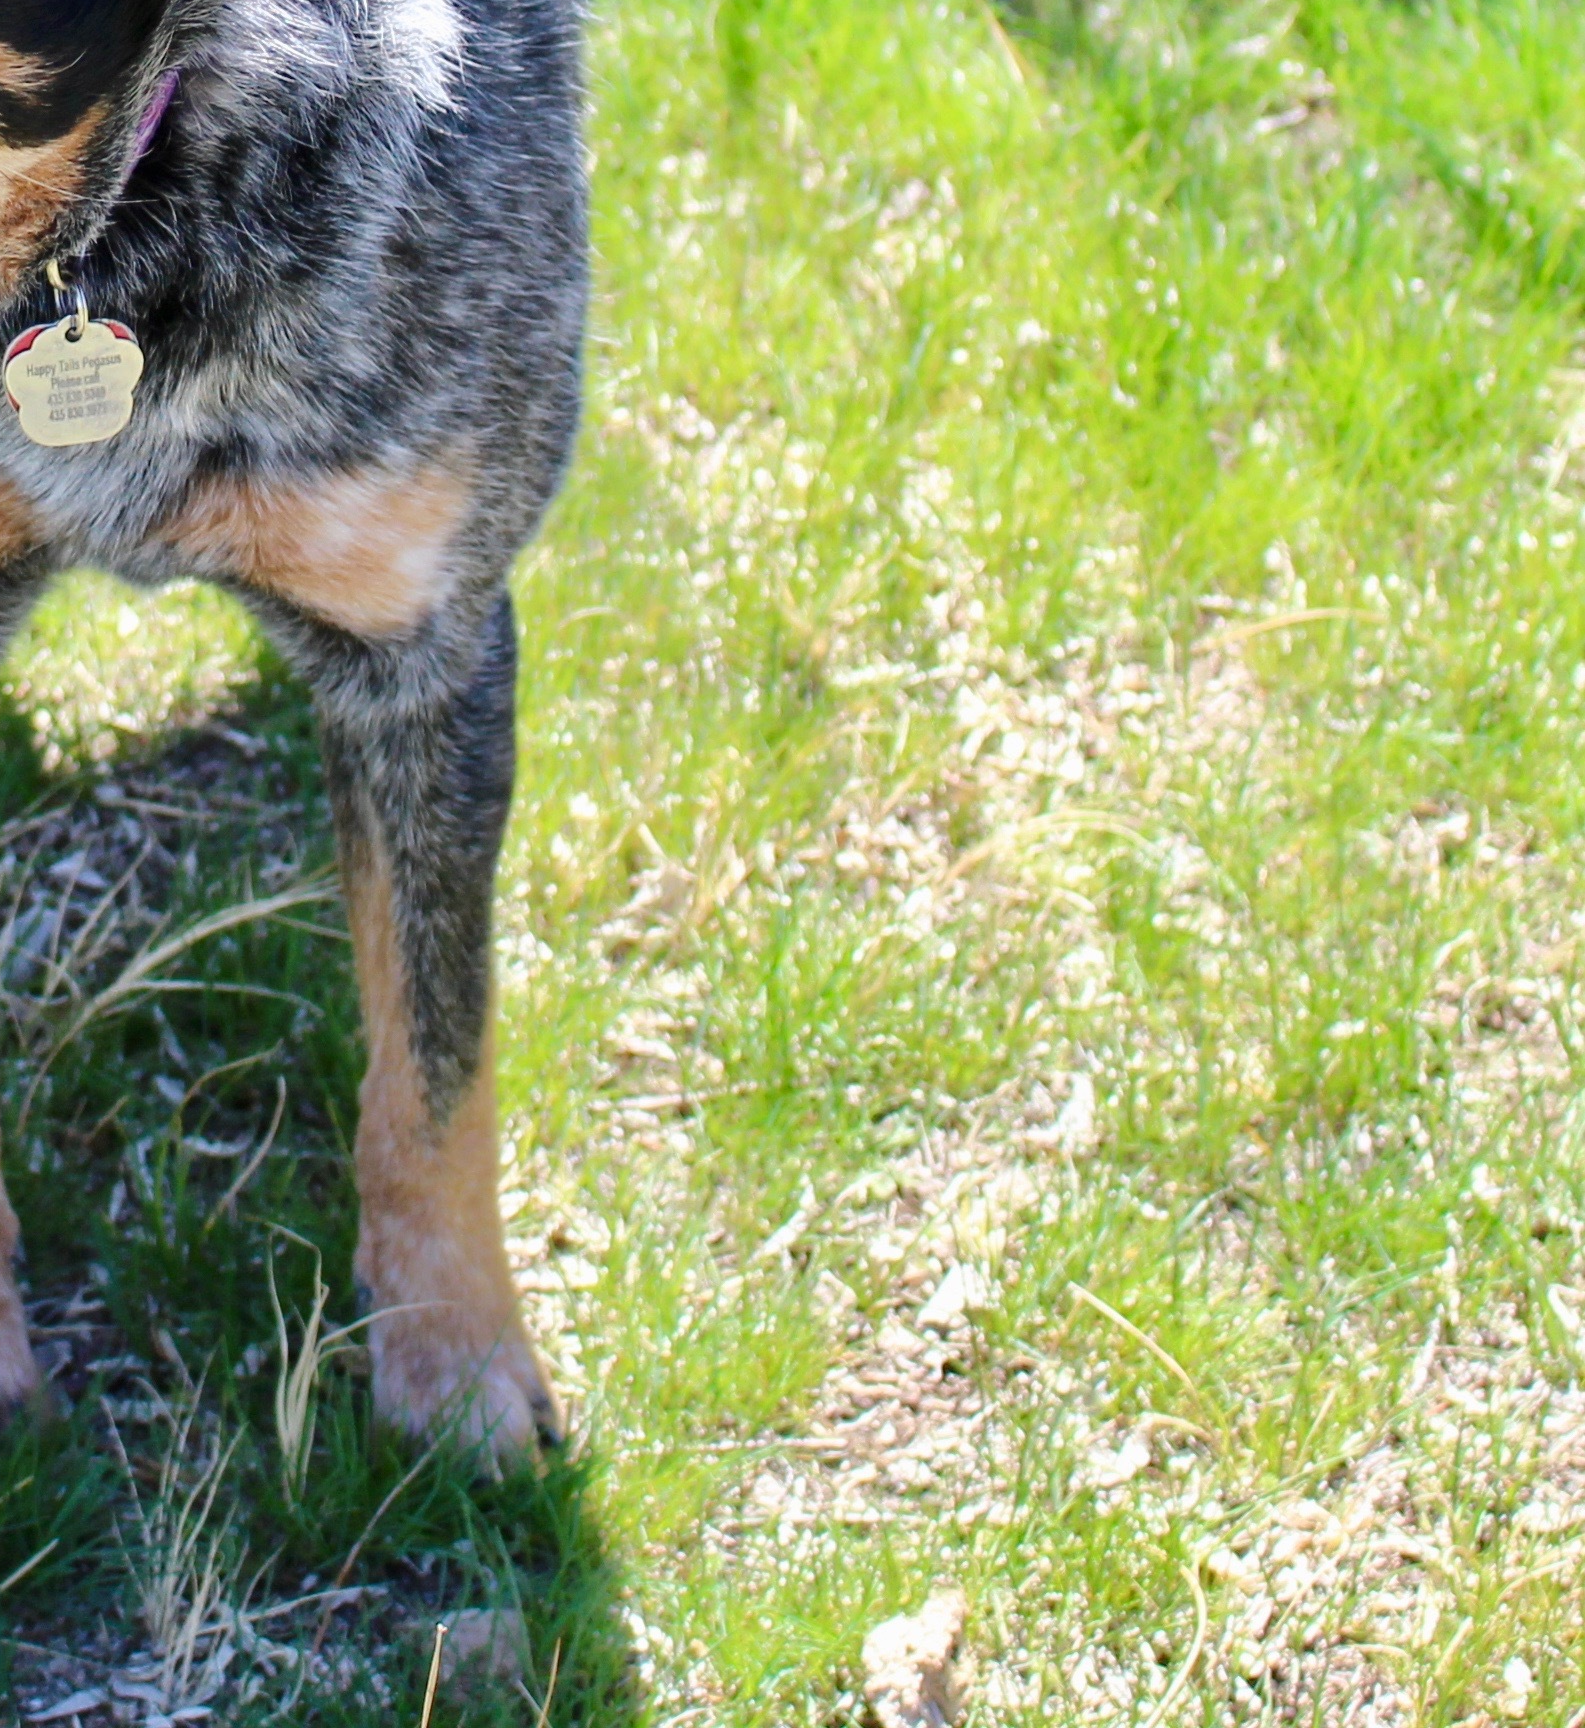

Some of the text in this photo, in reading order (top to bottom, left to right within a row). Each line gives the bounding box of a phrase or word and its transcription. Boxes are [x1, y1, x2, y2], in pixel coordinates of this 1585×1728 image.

[26, 354, 122, 378] Happy Tails Pegasus
[49, 408, 66, 421] 435
[67, 406, 84, 419] 830
